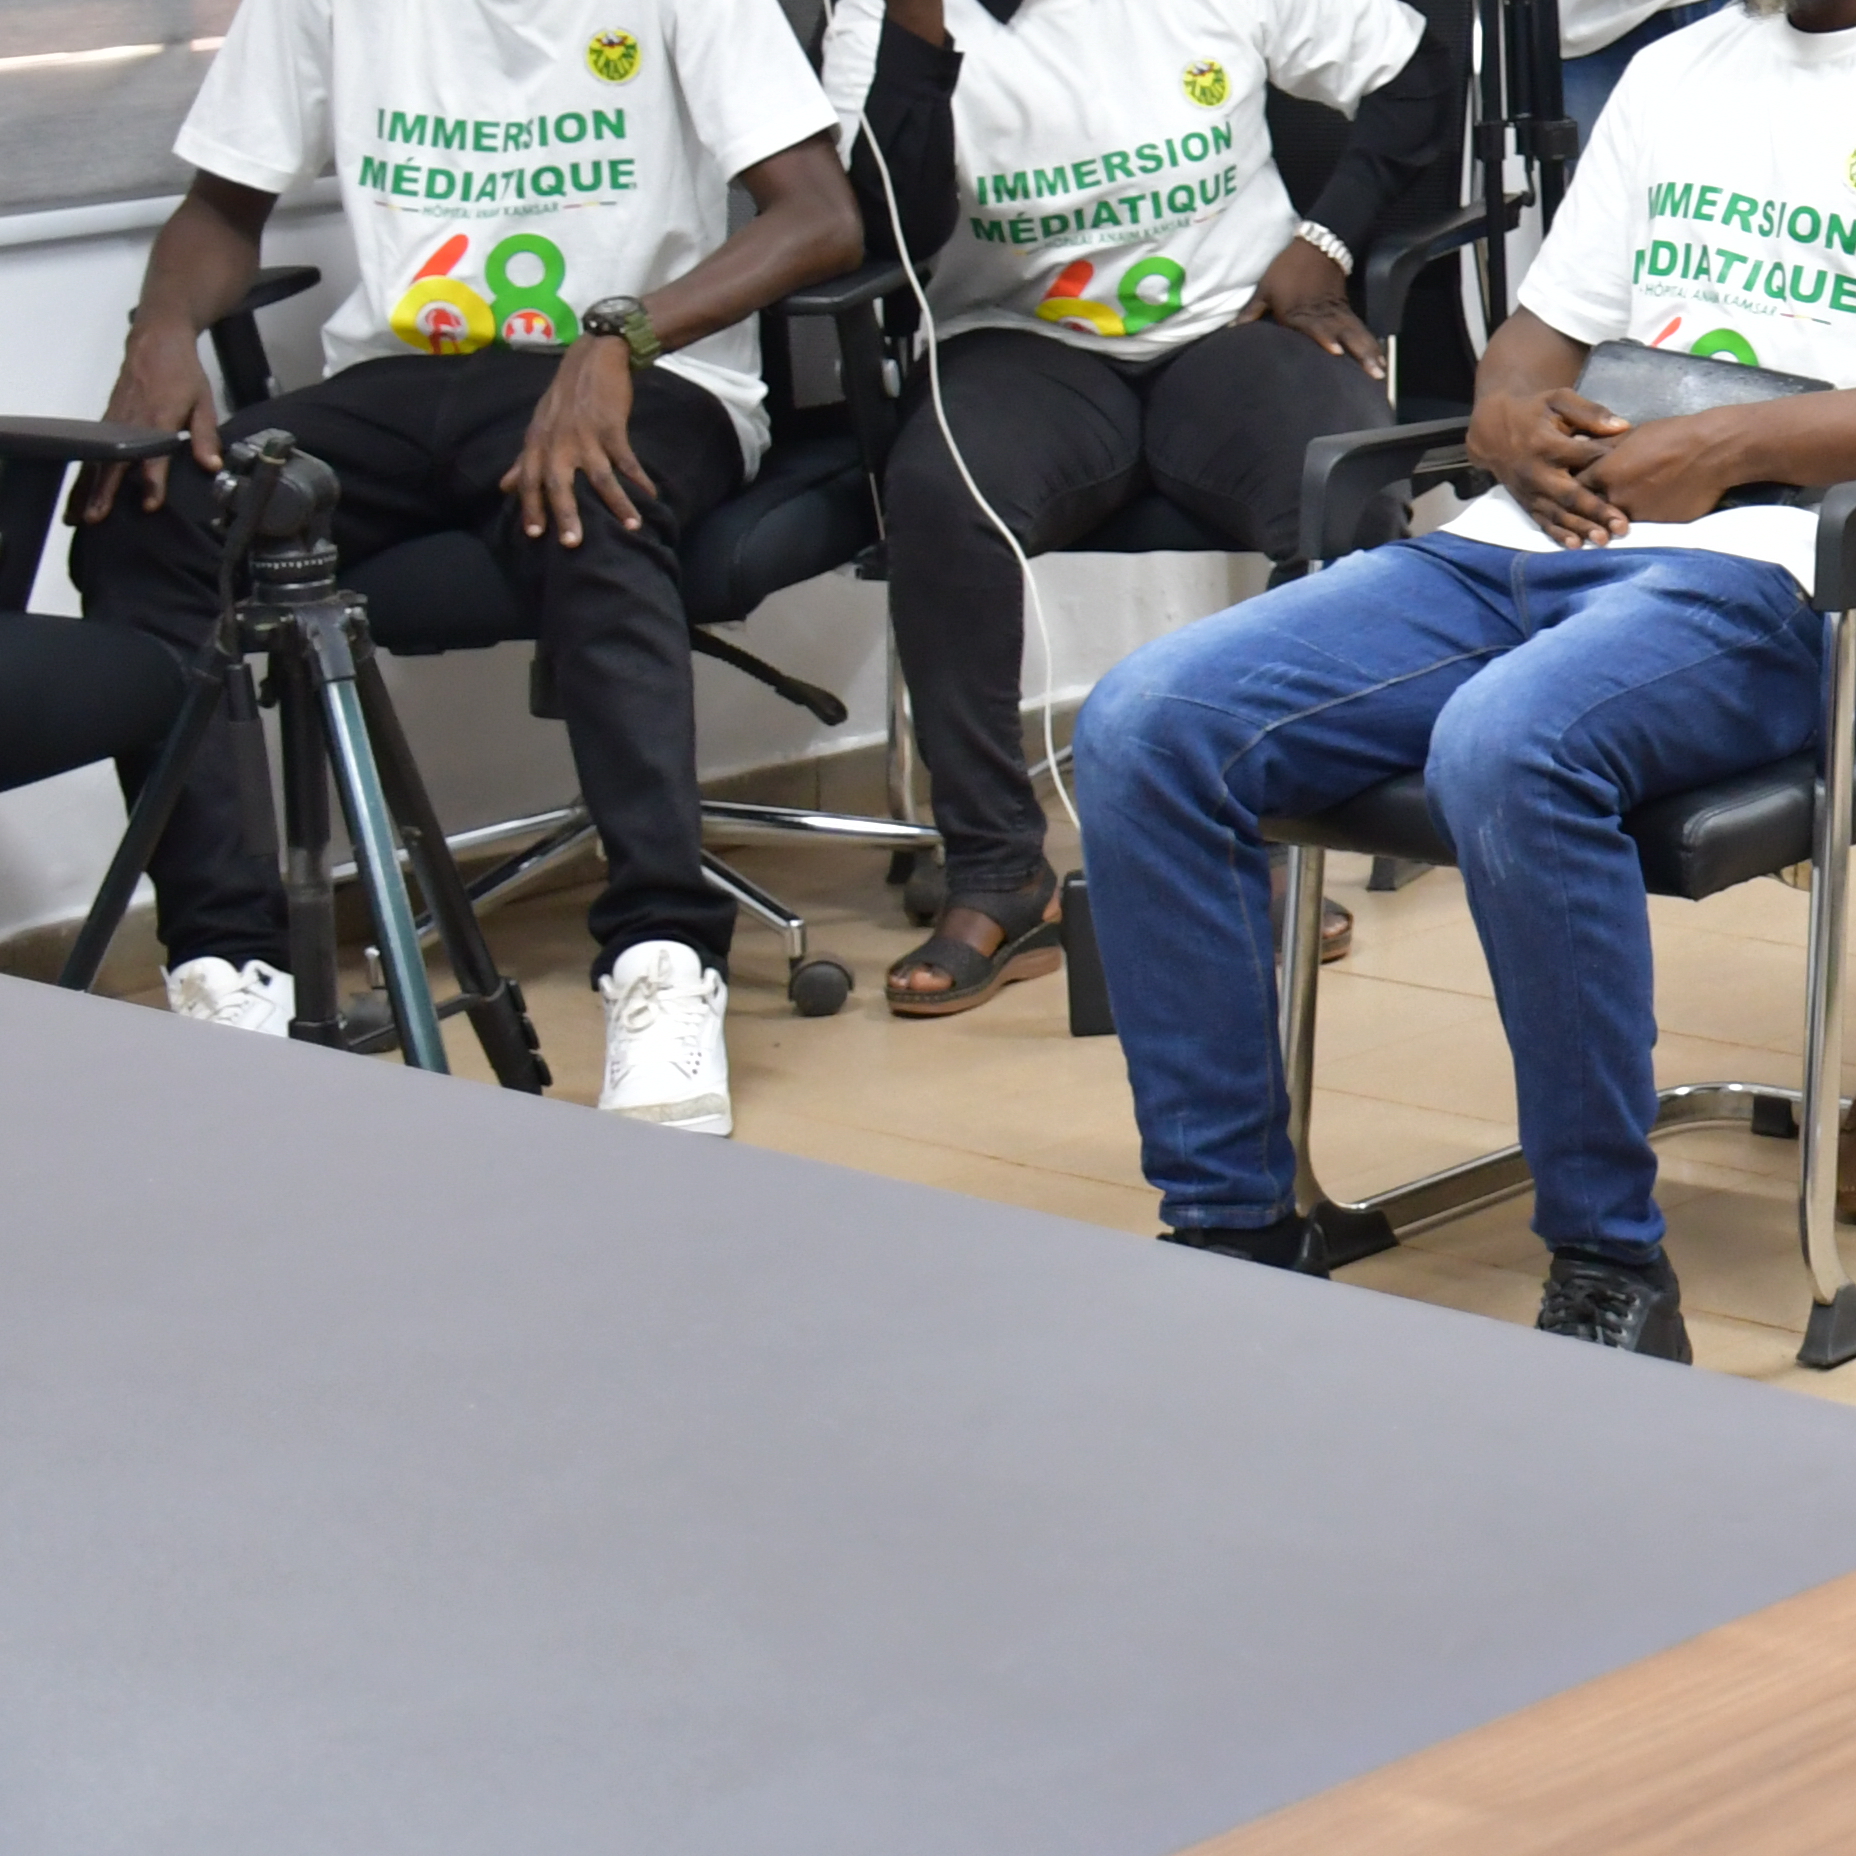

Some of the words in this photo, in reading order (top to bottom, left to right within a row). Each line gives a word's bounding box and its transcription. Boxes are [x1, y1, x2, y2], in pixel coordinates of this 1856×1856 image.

[377, 108, 627, 153] IMMERSION
[977, 120, 1233, 206] IMMERSION
[358, 155, 637, 203] MÉDIATIQUE
[969, 164, 1238, 245] MÉDIATIQUE
[389, 233, 581, 355] 68
